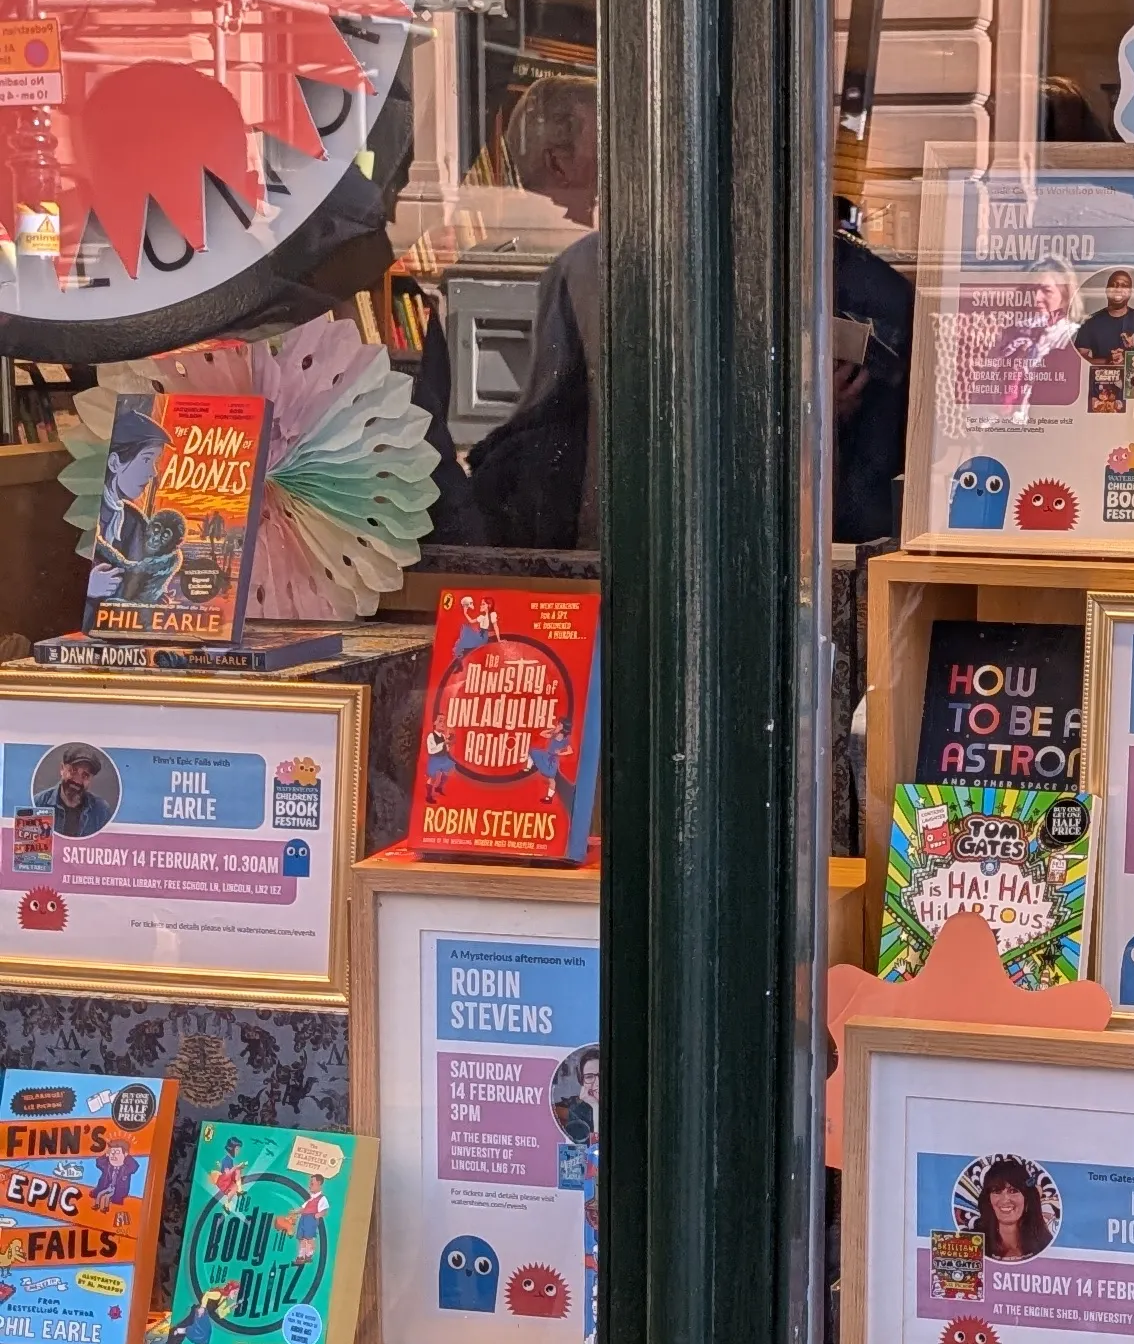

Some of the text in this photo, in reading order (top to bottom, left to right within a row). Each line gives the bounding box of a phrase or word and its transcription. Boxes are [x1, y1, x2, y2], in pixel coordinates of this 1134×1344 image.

[978, 201, 1034, 230] RYAN
[975, 235, 1094, 261] CRAWFORD
[183, 427, 241, 456] DAWN
[161, 458, 250, 494] ADONIS
[97, 611, 219, 632] PHIL EARLE
[950, 665, 1036, 697] HOW
[949, 703, 1052, 736] TO BE
[172, 771, 209, 794] PHIL
[163, 796, 216, 819] EARLE
[424, 807, 556, 840] ROBIN STEVENS
[970, 821, 1019, 839] TOM
[62, 846, 278, 873] SATURDAY 14 FEBRUARY, 10.30AM
[959, 837, 1024, 857] GATES
[929, 872, 1040, 904] is HA! HA!
[450, 950, 584, 966] A Mysterious afternoon with
[452, 967, 519, 998] ROBIN
[451, 1001, 552, 1033] STEVENS
[450, 1060, 522, 1081] SATURDAY
[450, 1082, 543, 1104] 14 FEBRUARY
[450, 1103, 480, 1121] 3PM
[7, 1126, 107, 1156] FINN'S
[1088, 1171, 1107, 1181] Tom
[7, 1173, 82, 1216] EPIC
[28, 1231, 120, 1260] FAILS
[993, 1272, 1071, 1295] SATURDAY
[1076, 1278, 1092, 1296] 14
